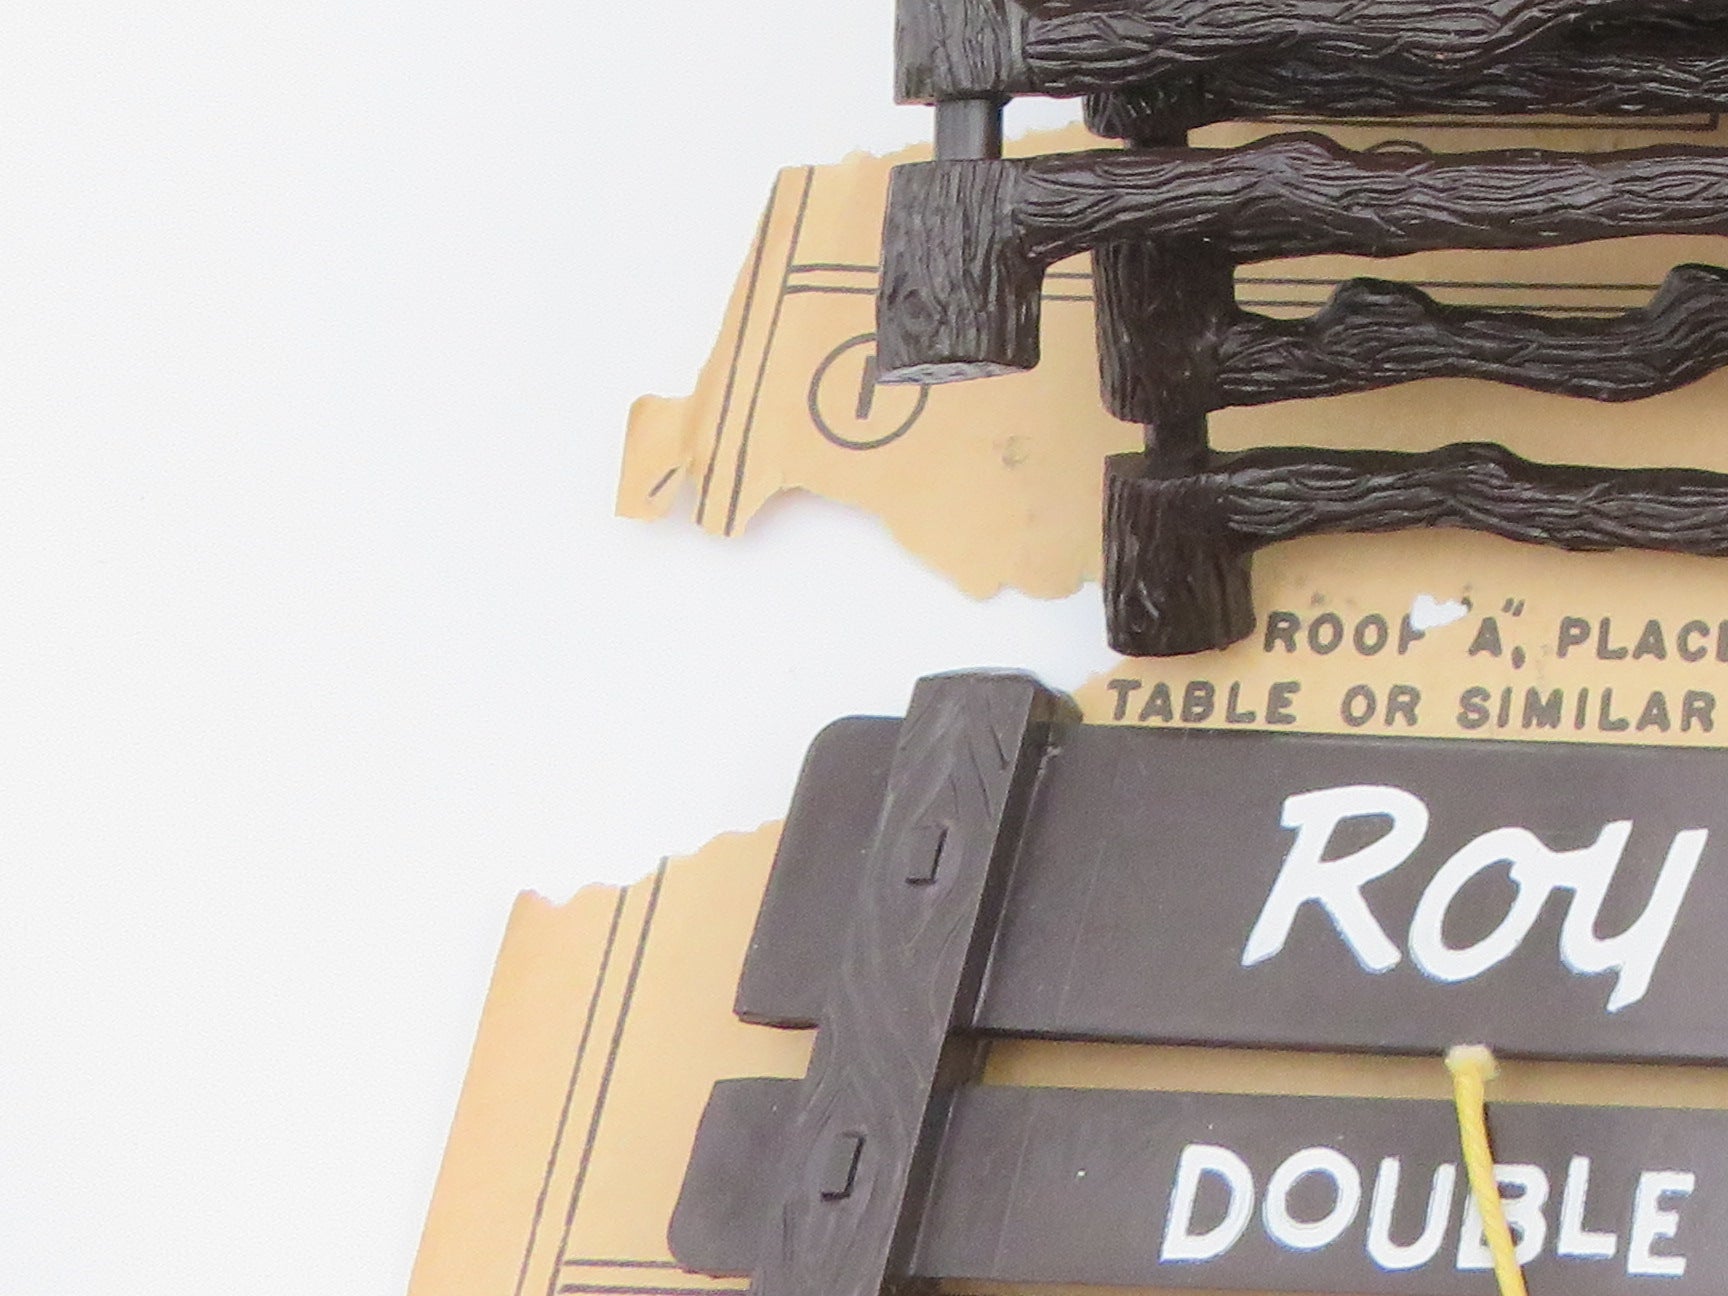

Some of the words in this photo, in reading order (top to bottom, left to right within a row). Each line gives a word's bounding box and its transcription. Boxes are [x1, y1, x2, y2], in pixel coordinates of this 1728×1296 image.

[1109, 679, 1299, 724] TABLE
[1342, 685, 1420, 727] OR
[1458, 687, 1715, 732] SIMILAR
[1242, 785, 1708, 1011] Roy
[1161, 1145, 1695, 1275] DOUBLE
